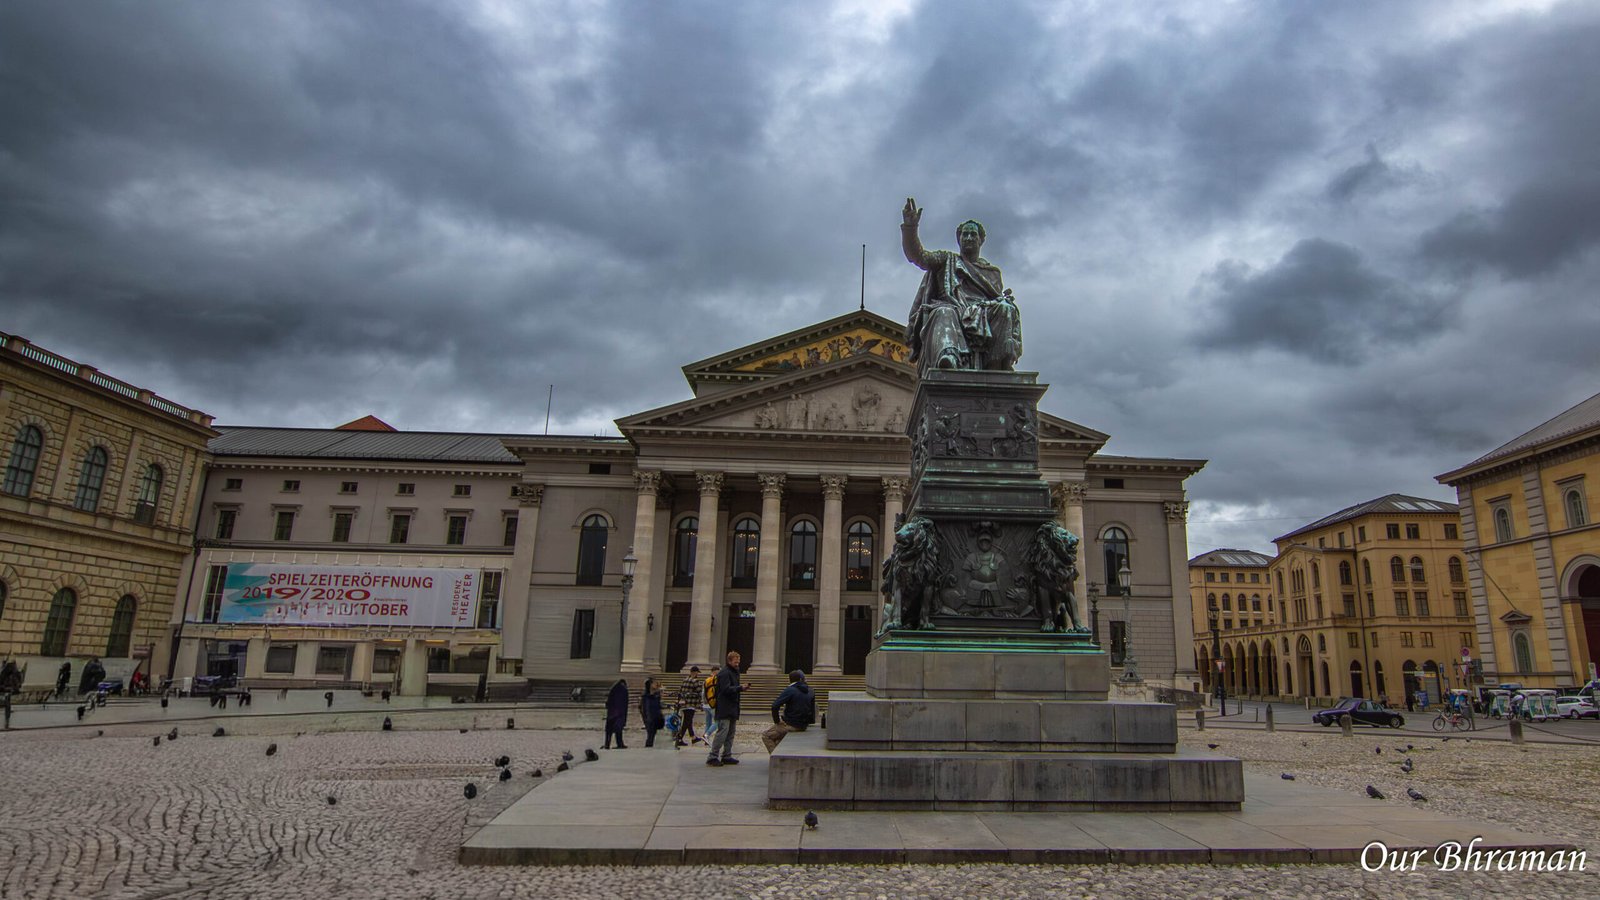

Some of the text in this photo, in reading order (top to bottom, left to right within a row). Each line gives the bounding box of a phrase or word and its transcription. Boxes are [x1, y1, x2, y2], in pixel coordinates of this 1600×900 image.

[242, 586, 371, 601] 2019/2020
[268, 571, 434, 589] SPIELZEITERÖFFNUNG
[451, 580, 462, 616] RESIDENZ
[458, 573, 473, 623] THEATER
